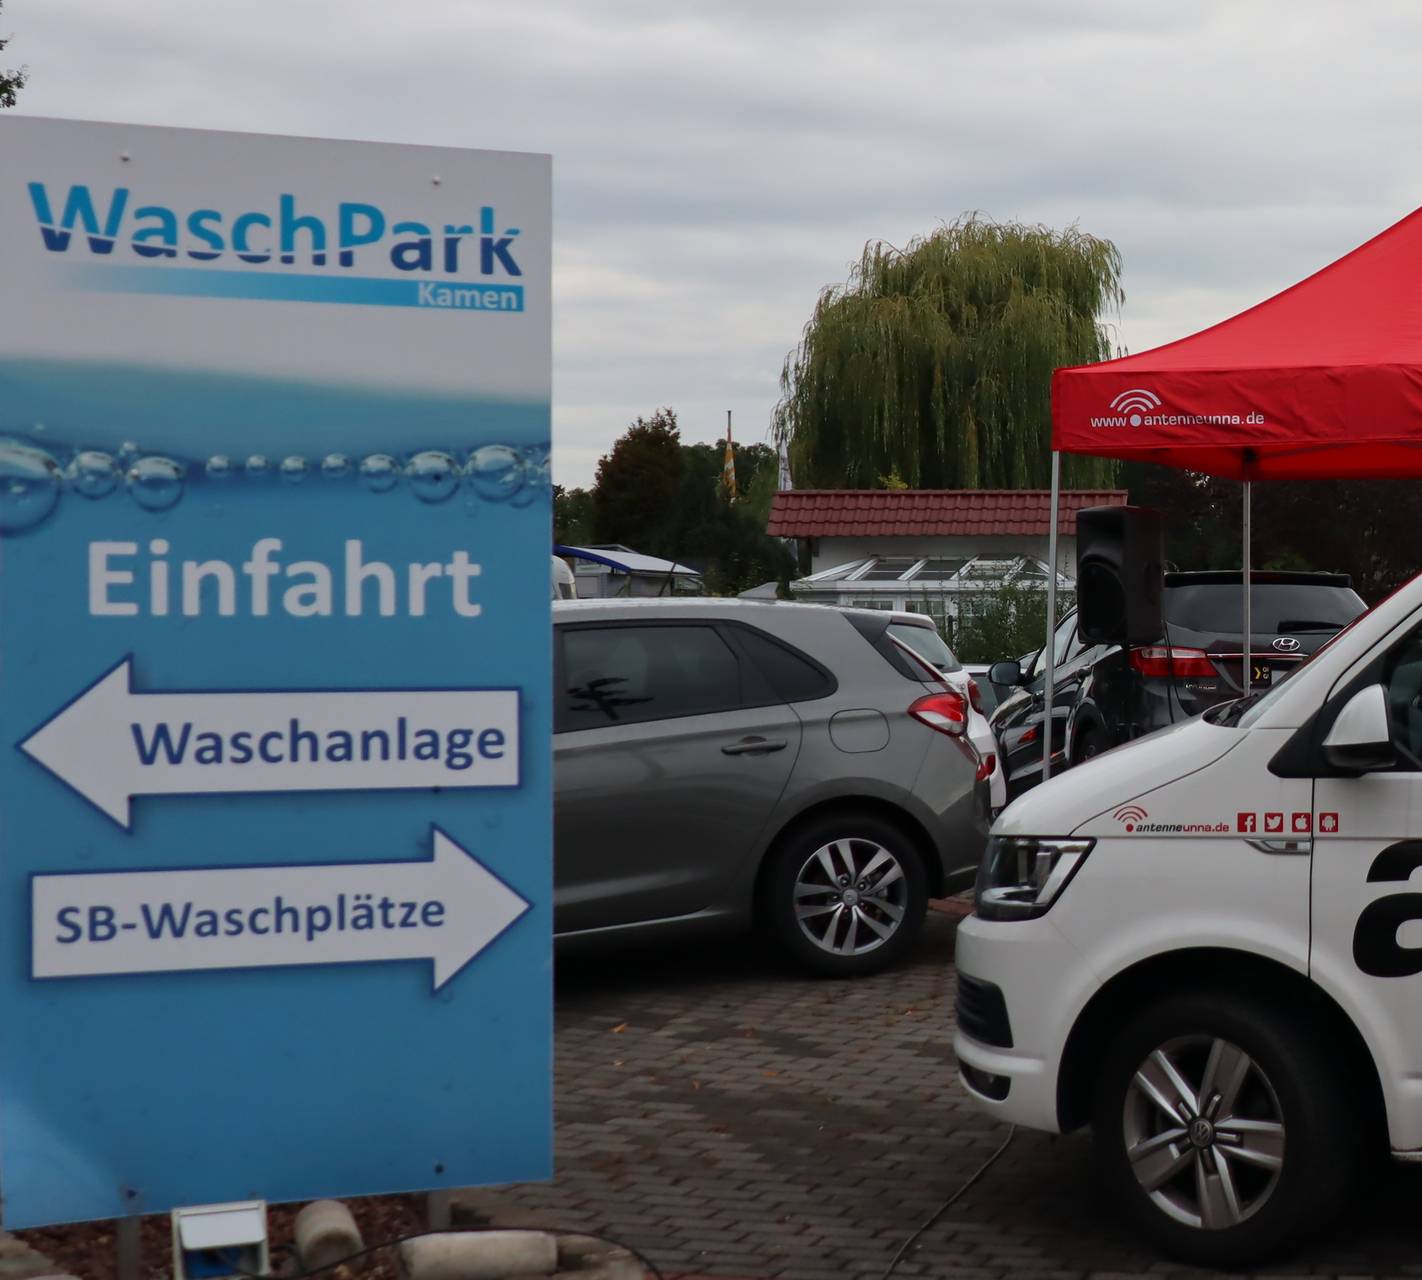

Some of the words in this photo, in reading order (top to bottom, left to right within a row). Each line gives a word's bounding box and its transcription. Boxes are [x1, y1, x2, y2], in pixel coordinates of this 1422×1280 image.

[28, 181, 522, 276] WaschPark
[417, 283, 517, 310] Kamen
[88, 537, 482, 617] Einfahrt
[131, 717, 506, 770] Waschanlage
[1136, 823, 1229, 833] antenneunna.de
[55, 894, 446, 944] SB-Waschplätze
